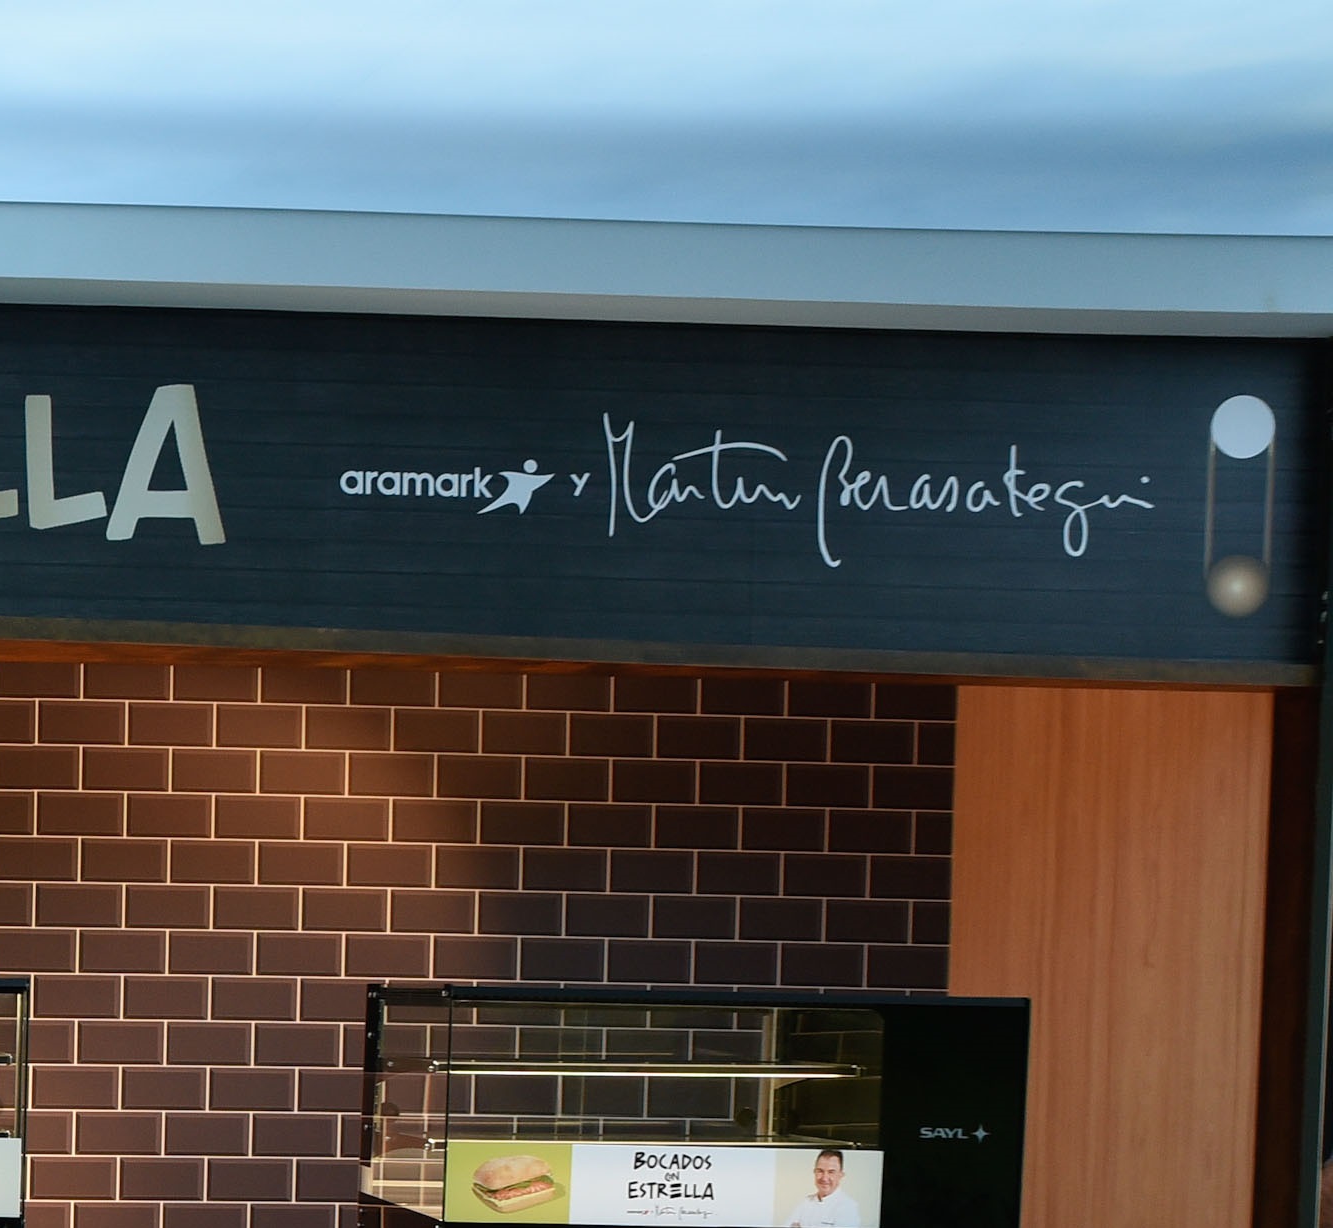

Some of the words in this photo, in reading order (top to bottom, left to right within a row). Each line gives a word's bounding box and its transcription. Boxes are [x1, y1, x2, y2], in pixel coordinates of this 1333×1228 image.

[340, 466, 493, 498] aramark
[919, 1127, 969, 1140] SAYL
[633, 1152, 712, 1170] BOCADOS
[628, 1181, 714, 1200] ESTRELLA
